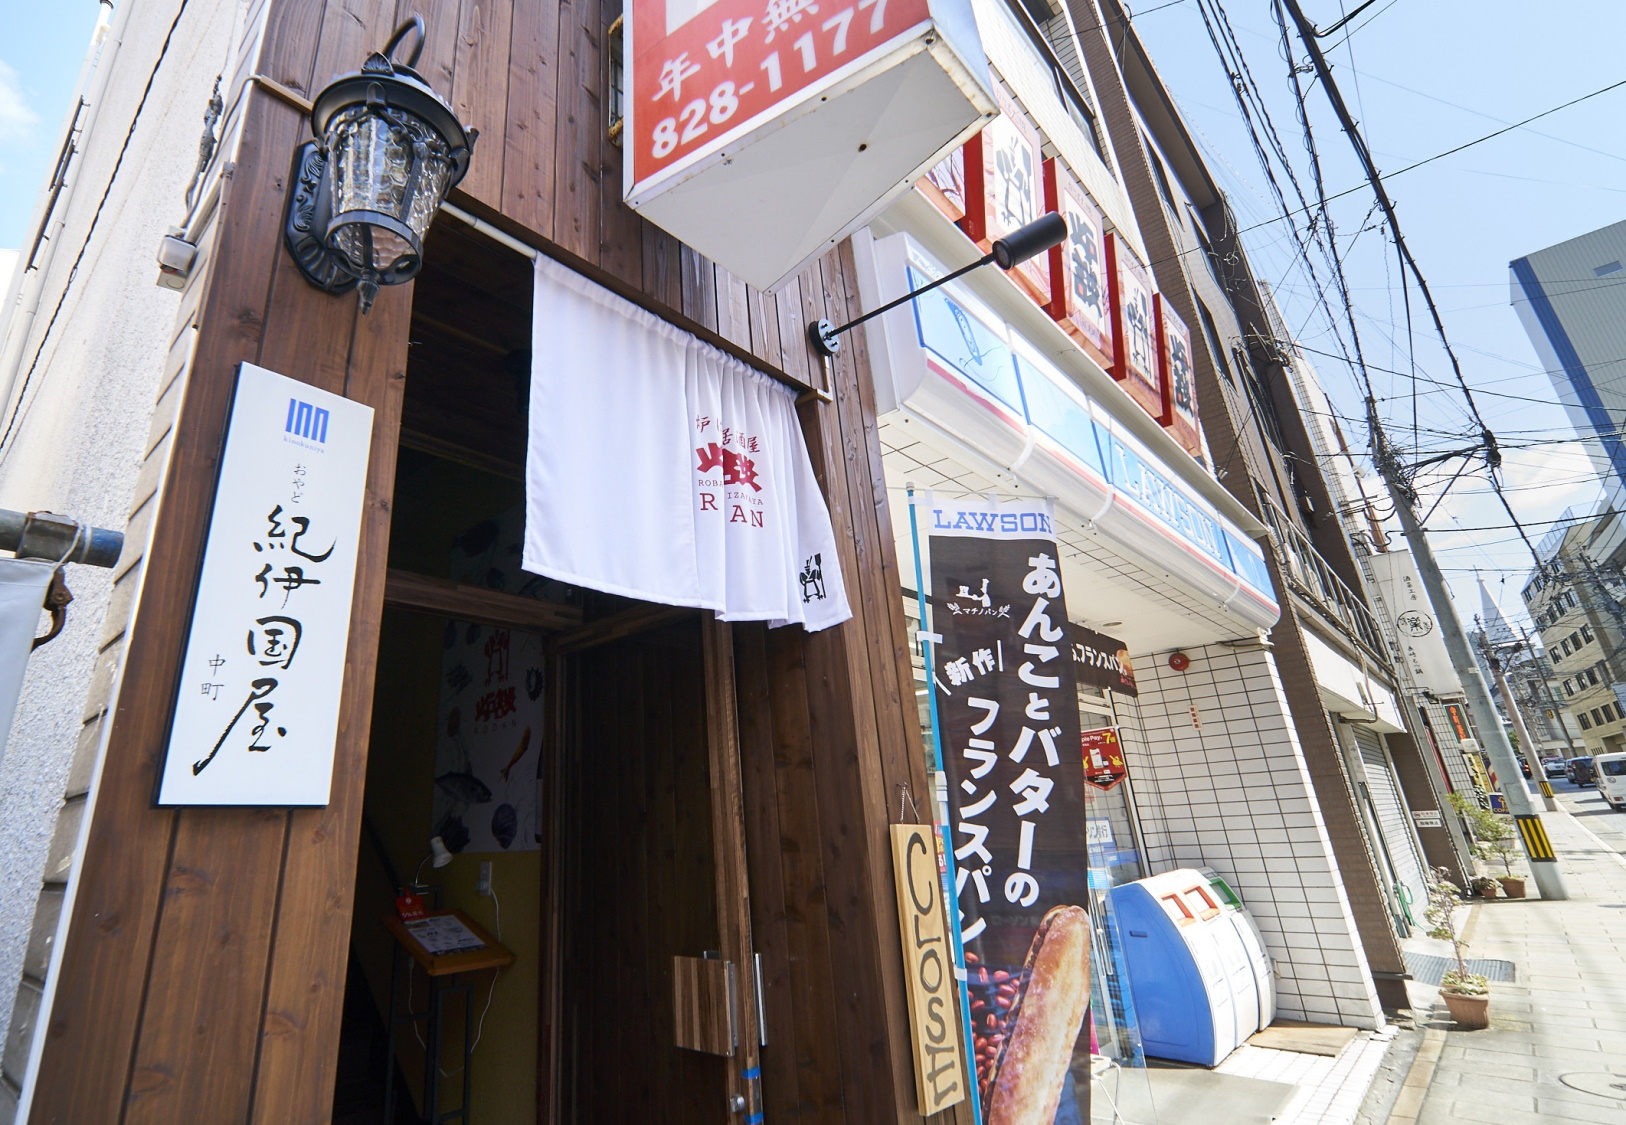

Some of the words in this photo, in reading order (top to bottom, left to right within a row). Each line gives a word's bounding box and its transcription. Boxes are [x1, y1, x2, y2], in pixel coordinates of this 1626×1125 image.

[651, 0, 889, 159] 828-1177
[283, 435, 325, 454] kinokuniya
[290, 463, 307, 504] おやど
[1114, 442, 1224, 561] LAWSON
[933, 509, 1053, 535] LAWSON
[963, 607, 998, 617] マチノパン
[193, 504, 337, 776] 紀伊国屋
[201, 653, 226, 701] 中町
[944, 647, 996, 687] 新作
[473, 719, 518, 736] RODAN
[1004, 552, 1063, 907] あんことバターの
[954, 697, 1000, 945] フランスパン
[905, 831, 959, 1108] CLOSE
